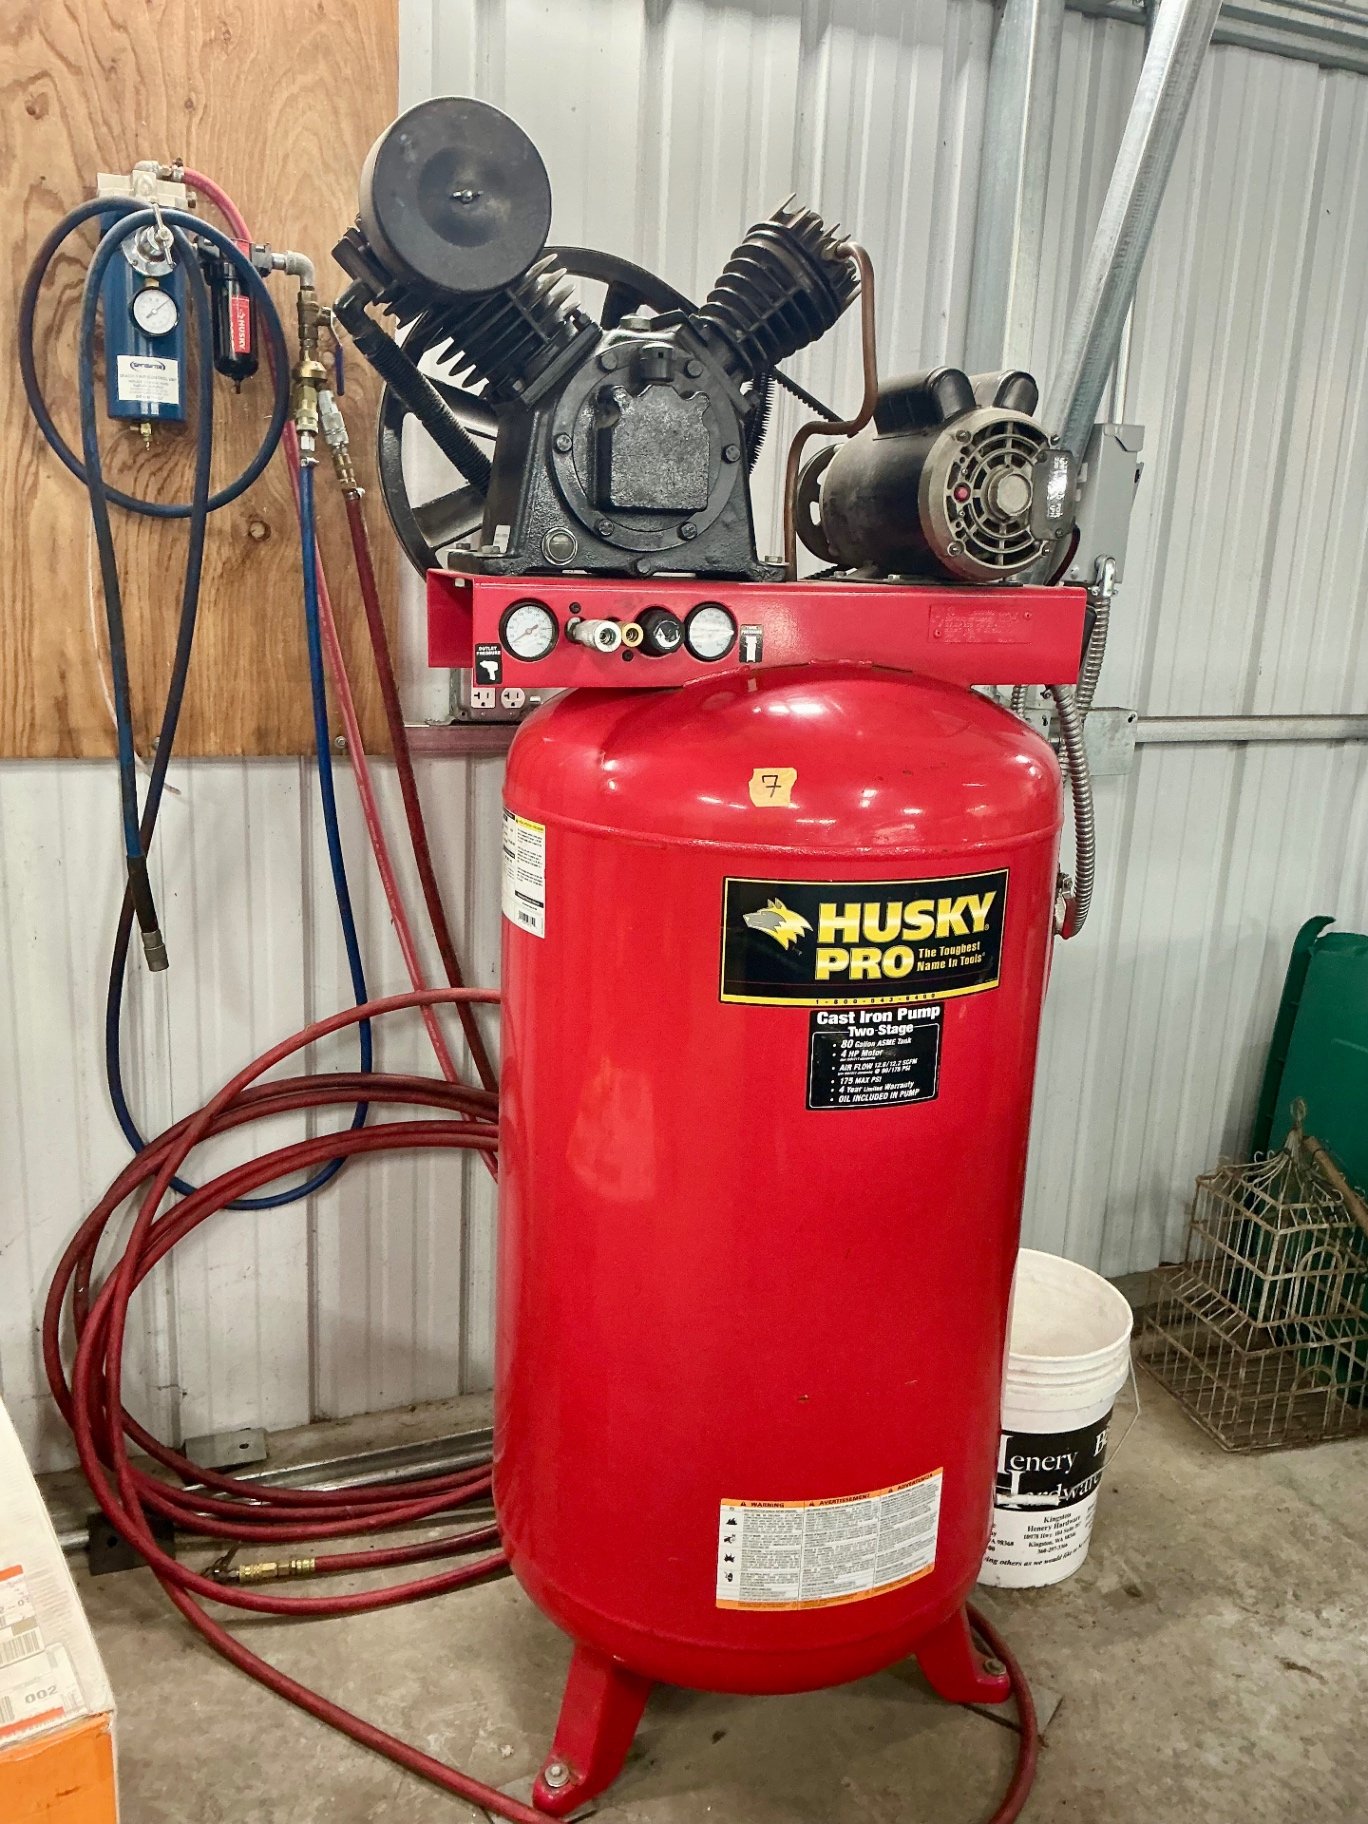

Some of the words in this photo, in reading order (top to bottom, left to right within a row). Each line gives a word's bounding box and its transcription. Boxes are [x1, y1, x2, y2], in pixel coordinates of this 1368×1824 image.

[762, 775, 782, 798] 7
[817, 890, 997, 944] HUSKY
[918, 948, 937, 959] The
[939, 941, 981, 957] Toughest
[815, 945, 915, 980] PRO
[917, 958, 946, 972] Name
[948, 957, 958, 968] In
[960, 953, 983, 966] Tools
[817, 1011, 856, 1025] Cast
[859, 1010, 893, 1024] Iron
[897, 1006, 941, 1021] Pump
[841, 1039, 853, 1049] 80
[854, 1040, 876, 1049] Gallon
[876, 1038, 897, 1048] ASME
[897, 1037, 912, 1045] Tank
[840, 1050, 847, 1058] 4
[848, 1049, 860, 1057] HP
[861, 1049, 884, 1057] Motor
[839, 1063, 852, 1072] AIR
[854, 1062, 874, 1071] FLOW
[902, 1058, 918, 1066] SCFM
[840, 1077, 854, 1085] 175
[855, 1076, 870, 1084] MAX
[870, 1075, 882, 1083] PSI
[838, 1086, 845, 1094] 4
[884, 1081, 915, 1091] Warranty
[838, 1094, 851, 1103] OIL
[852, 1092, 888, 1102] INCLUDED
[889, 1090, 898, 1099] IN
[899, 1088, 920, 1098] PUMP
[819, 1494, 870, 1506] AVERTISSEMENT
[1043, 1513, 1072, 1523] Kingston
[1053, 1515, 1081, 1529] Hardware
[999, 1559, 1022, 1567] others
[1044, 1555, 1062, 1564] would
[24, 1685, 59, 1705] 002
